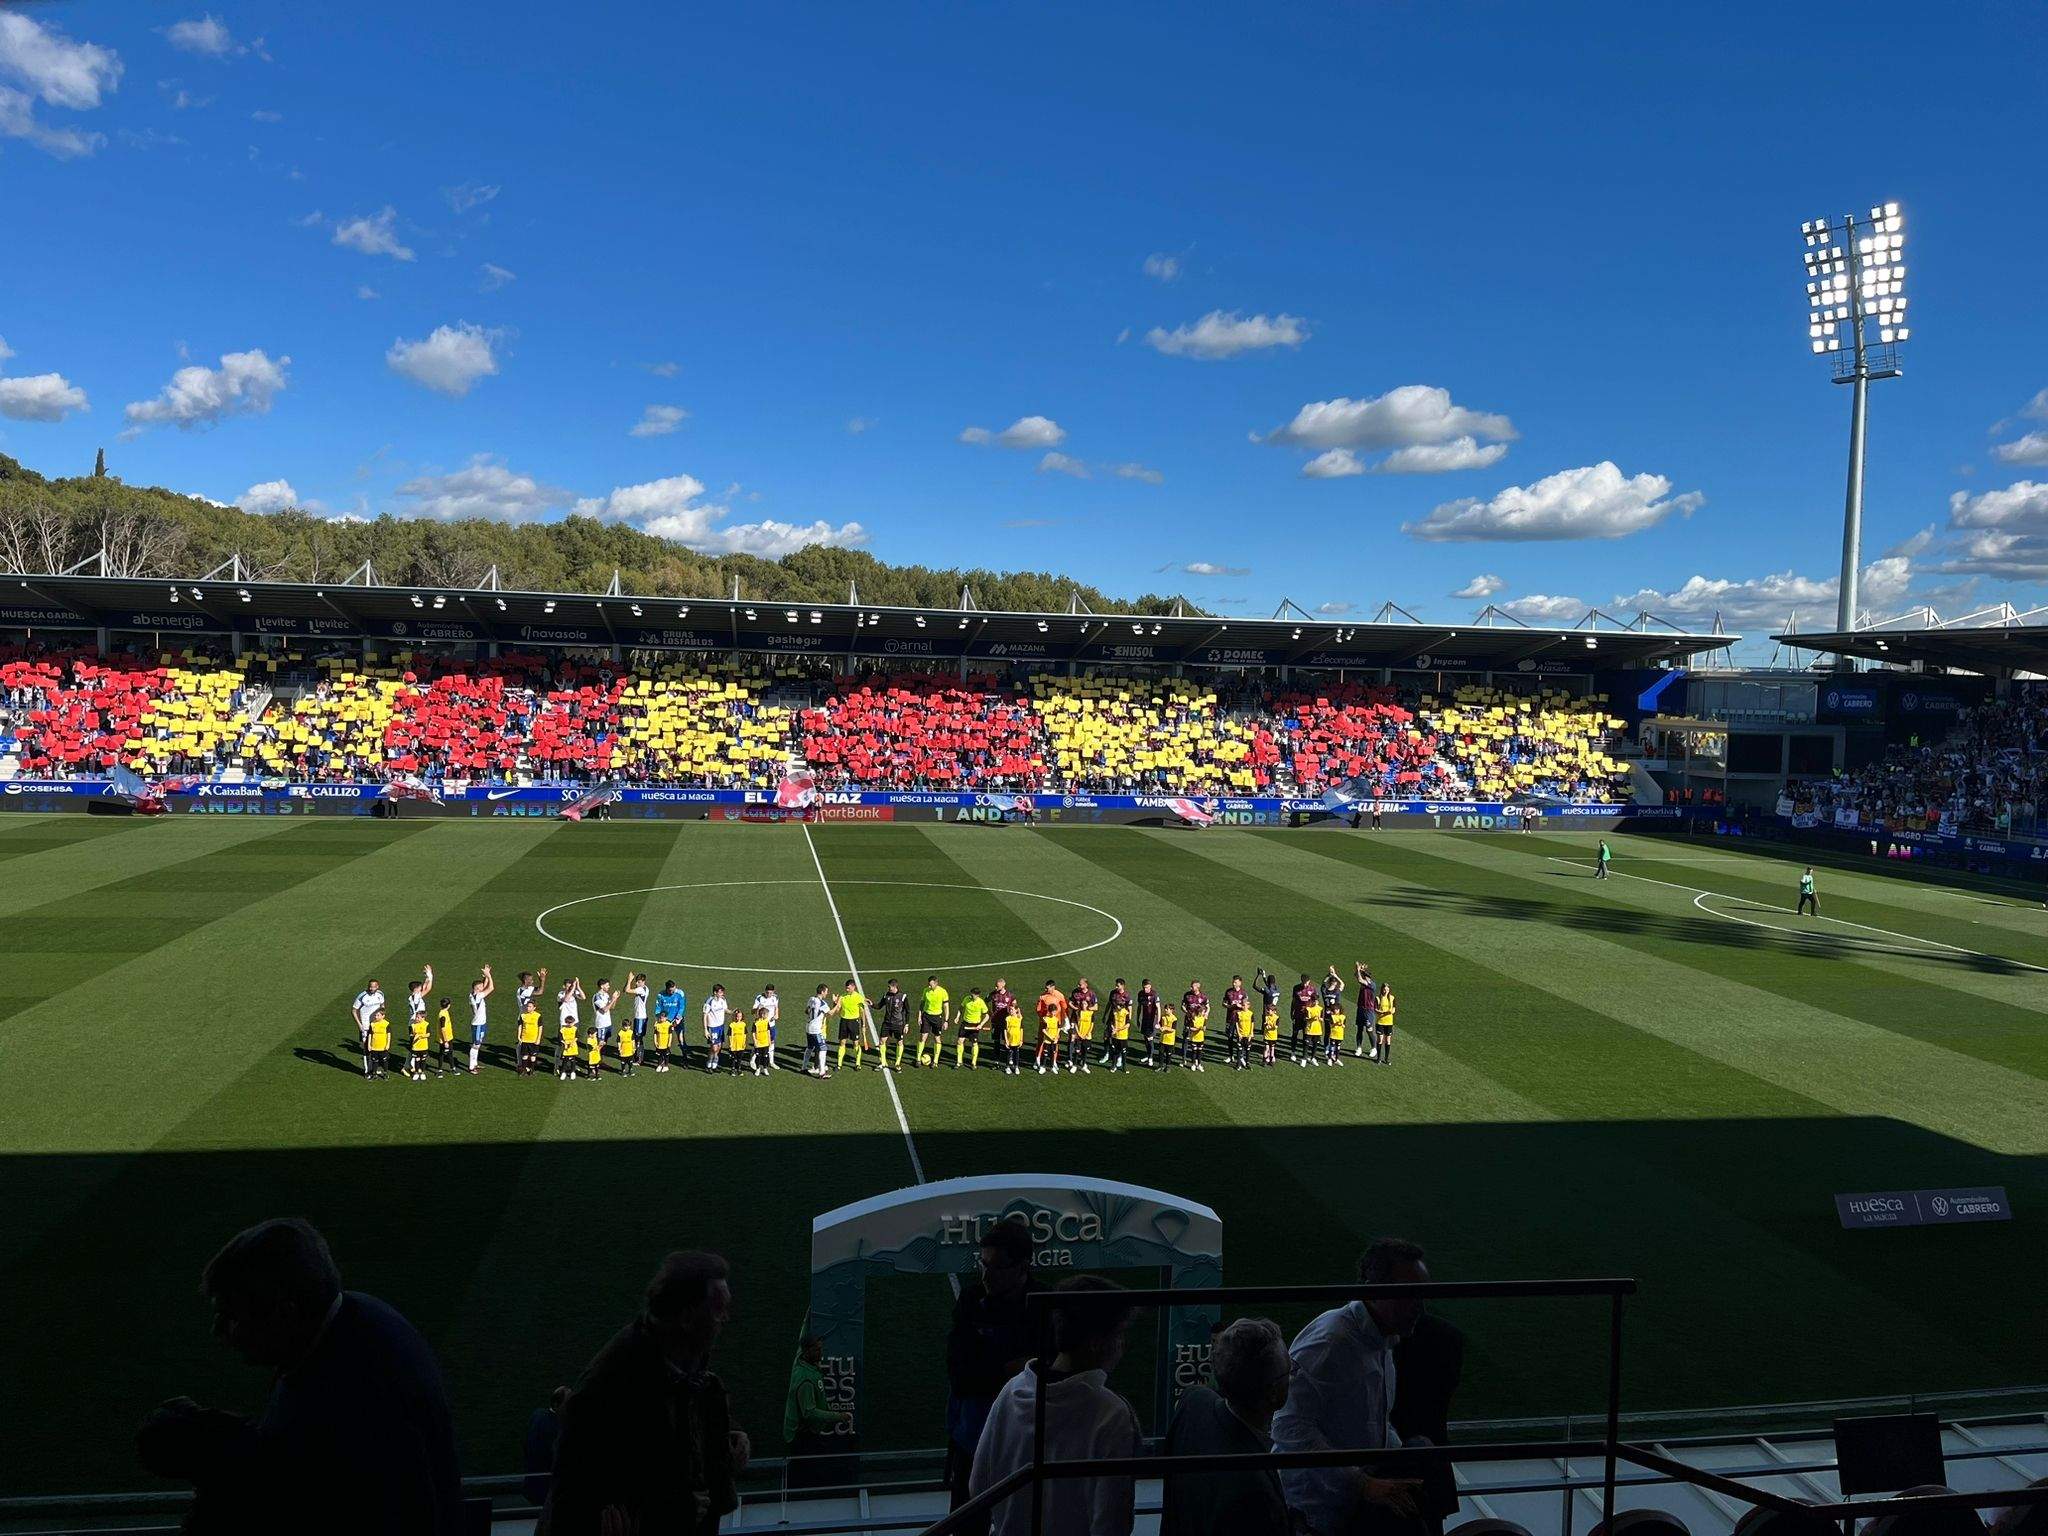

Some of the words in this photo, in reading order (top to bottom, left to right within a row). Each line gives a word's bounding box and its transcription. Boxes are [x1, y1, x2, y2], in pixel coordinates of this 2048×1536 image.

[423, 629, 474, 638] CABRERO
[899, 640, 932, 651] arnal
[1009, 644, 1046, 653] MAZANA
[1223, 651, 1264, 660] DOMEC
[1843, 699, 1873, 708] CABRERO
[23, 785, 73, 793] COSEHISA
[213, 785, 263, 797] CaixaBank
[312, 786, 361, 797] CALLIZO
[745, 792, 768, 803] EL
[1358, 802, 1400, 813] CLAERIA
[1849, 1198, 1905, 1214] Huesca
[1956, 1203, 2000, 1215] CABRERO
